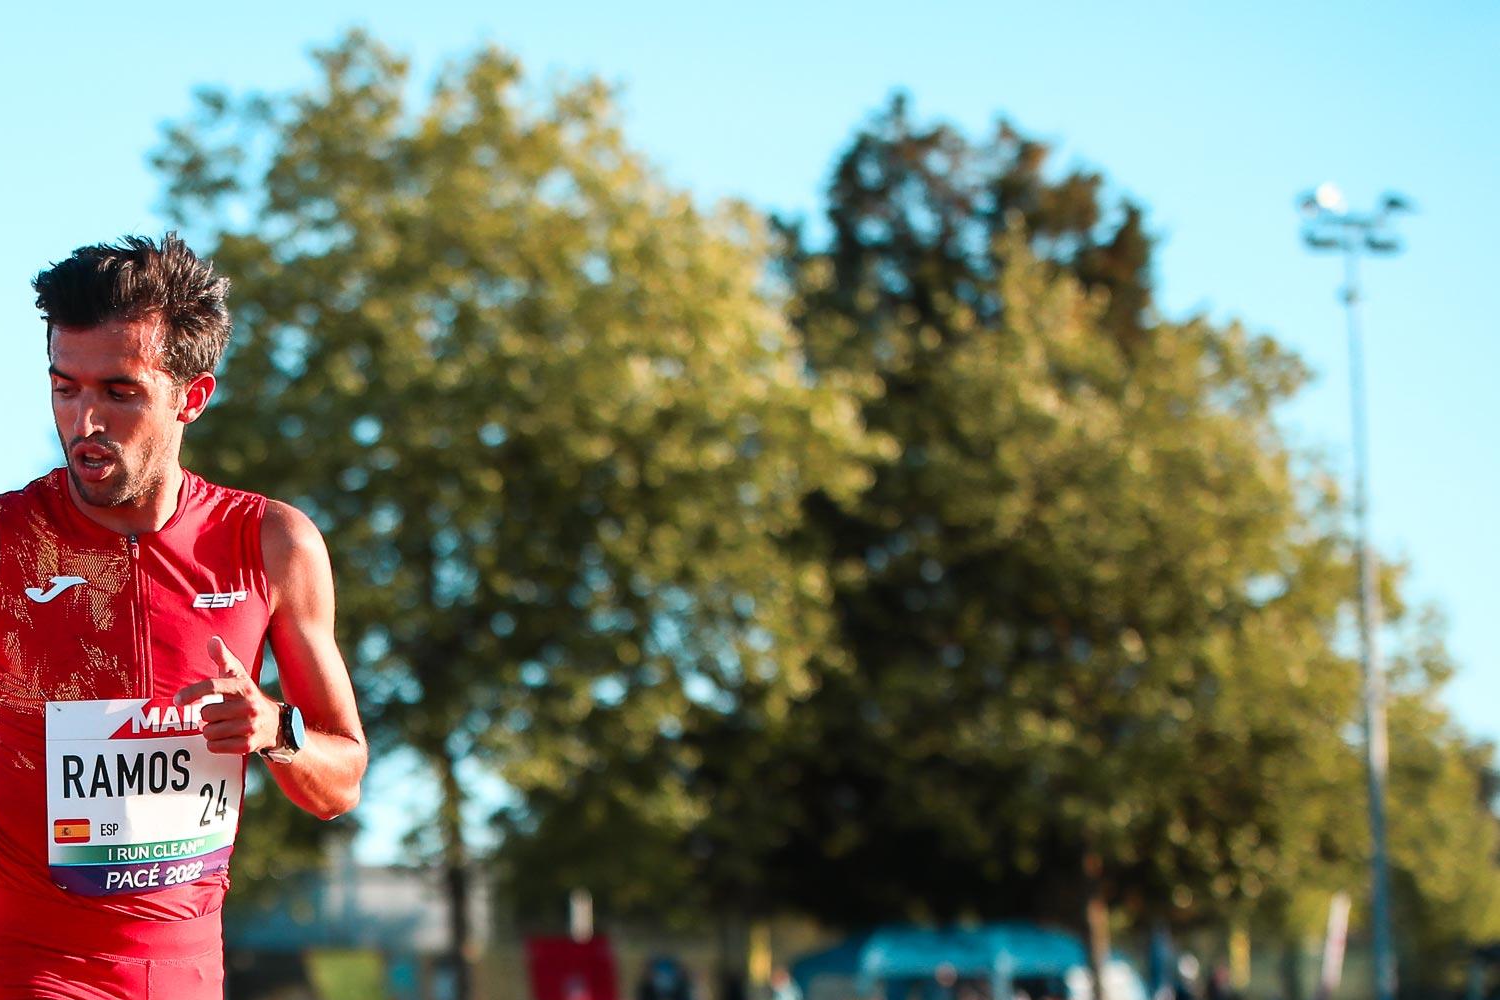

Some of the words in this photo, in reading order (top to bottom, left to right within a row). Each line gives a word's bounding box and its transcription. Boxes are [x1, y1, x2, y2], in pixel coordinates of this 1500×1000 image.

[192, 591, 248, 609] ESP
[62, 749, 191, 799] RAMOS
[199, 779, 228, 828] 24
[100, 823, 119, 837] ESP
[108, 848, 112, 861] I
[117, 845, 150, 861] RUN
[105, 862, 161, 890] PACÉ
[164, 860, 205, 886] 2022
